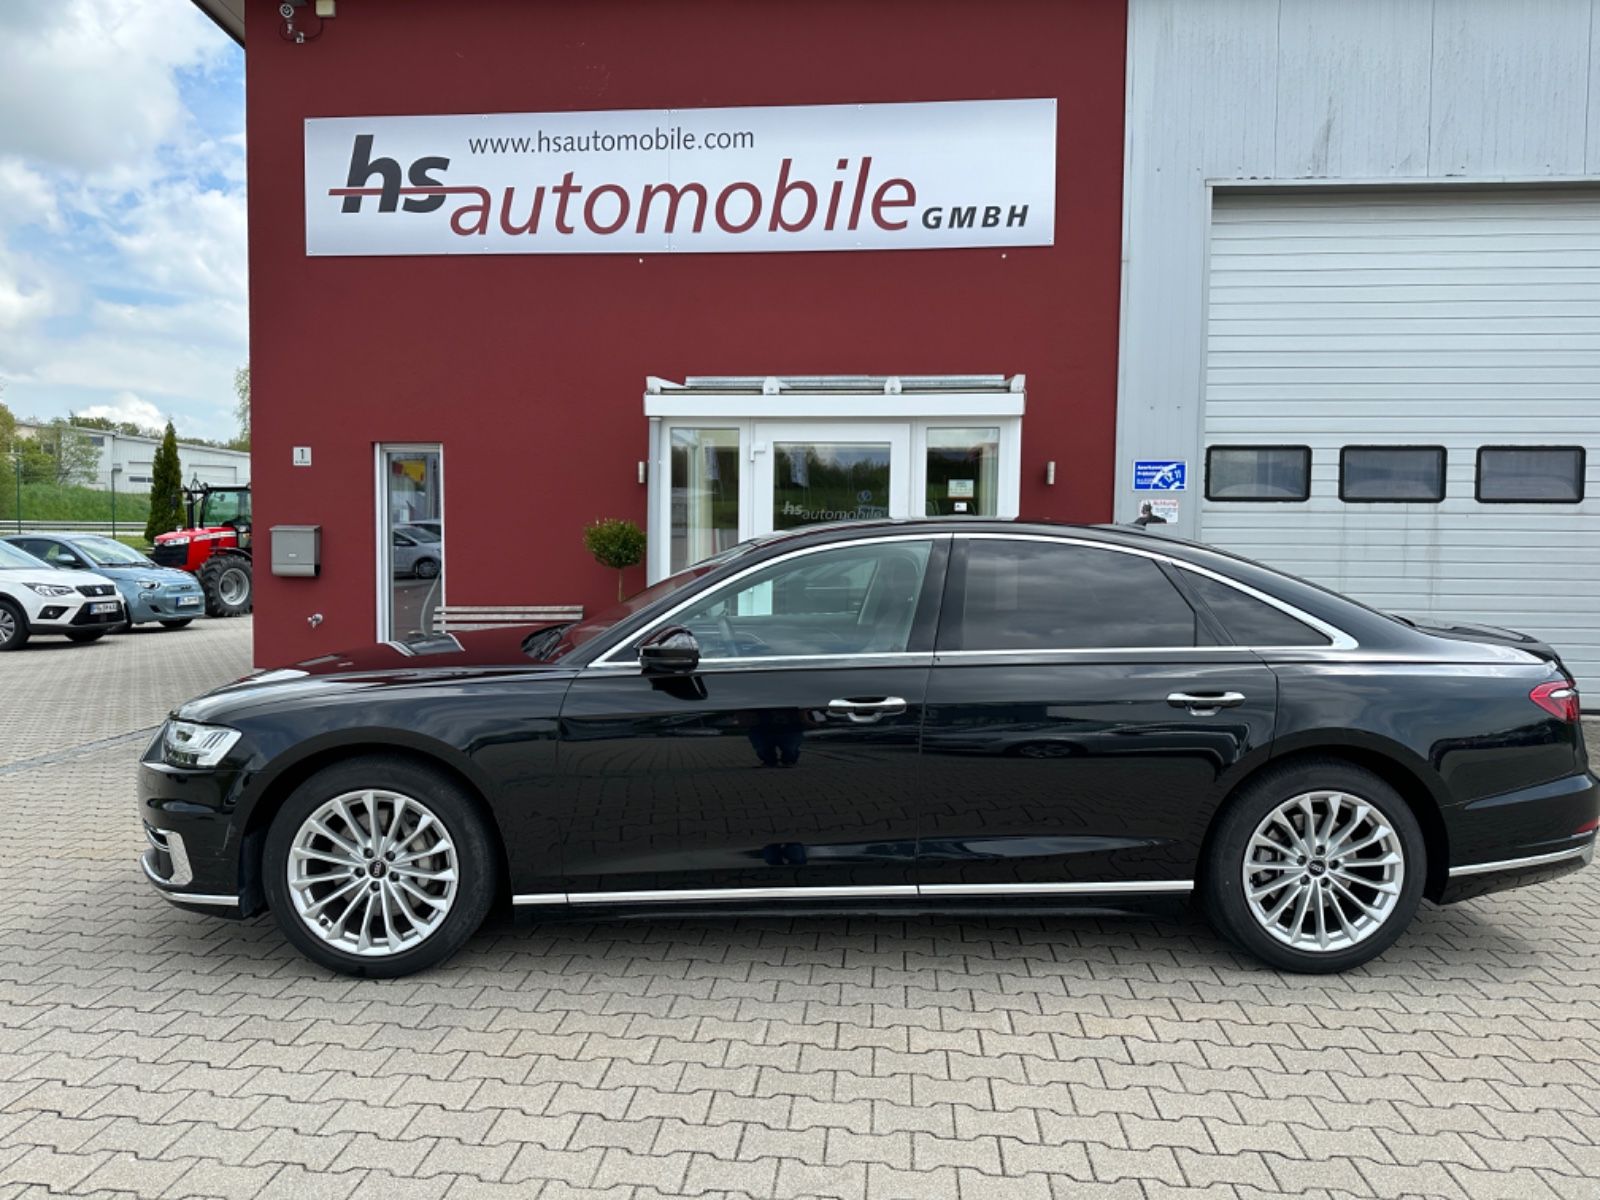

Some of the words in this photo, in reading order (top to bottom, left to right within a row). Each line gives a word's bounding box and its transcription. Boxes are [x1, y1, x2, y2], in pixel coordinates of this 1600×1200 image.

[468, 126, 755, 155] www.hsautomobile.com
[449, 157, 917, 237] automobile
[921, 203, 1030, 230] GMBH
